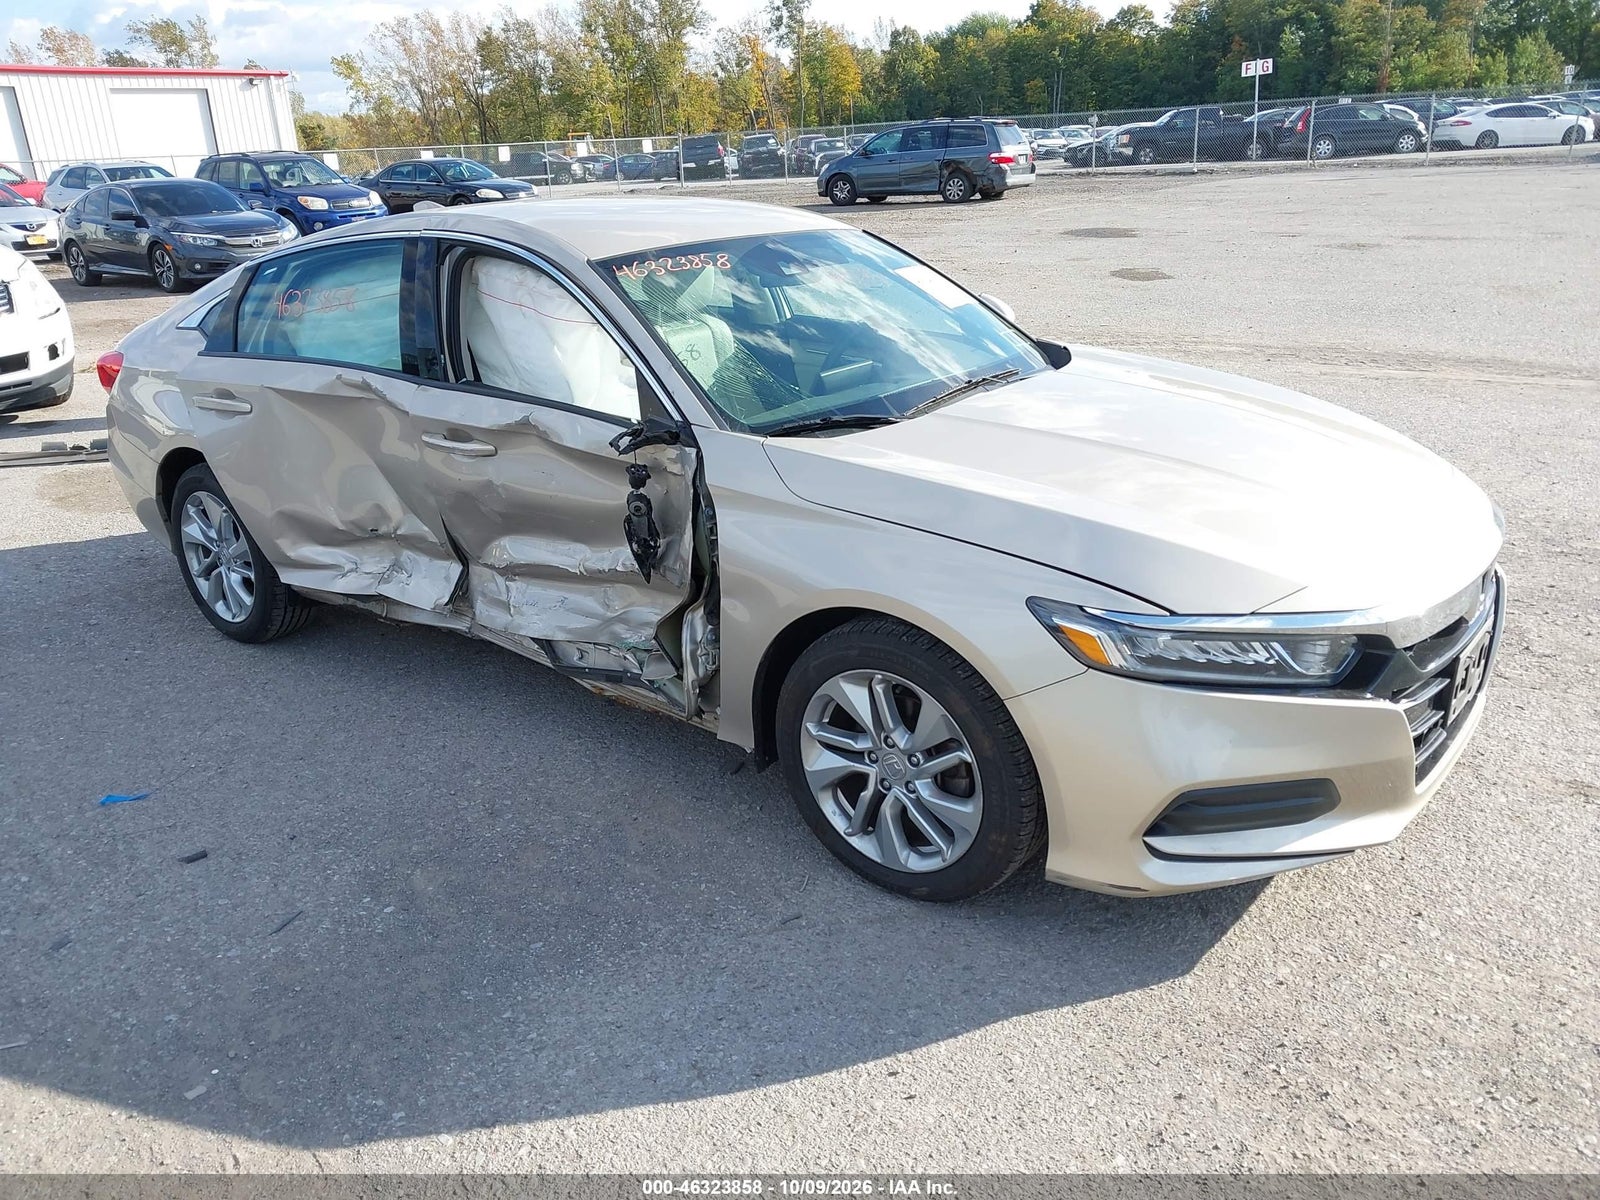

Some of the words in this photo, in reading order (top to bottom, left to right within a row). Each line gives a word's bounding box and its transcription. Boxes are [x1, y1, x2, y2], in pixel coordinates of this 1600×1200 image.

[1245, 63, 1252, 75] F
[1261, 60, 1270, 73] G
[612, 252, 731, 281] 46323858
